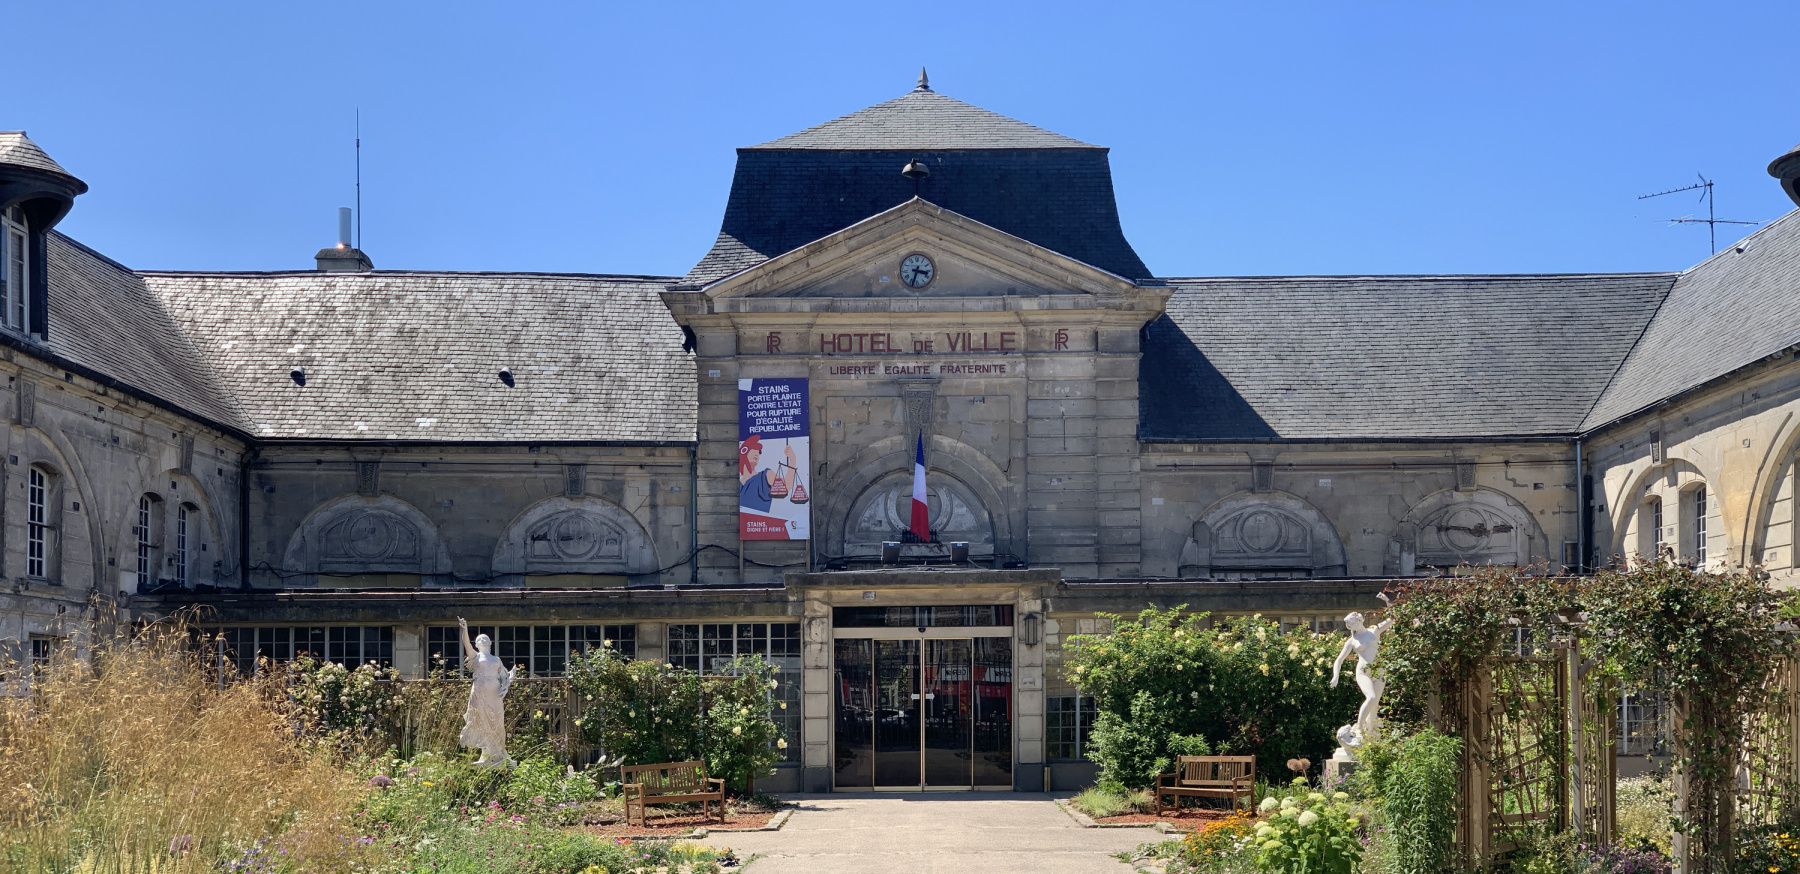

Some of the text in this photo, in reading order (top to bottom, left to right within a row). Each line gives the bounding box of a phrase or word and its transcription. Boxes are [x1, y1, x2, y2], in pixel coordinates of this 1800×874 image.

[820, 331, 1016, 353] HOTEL DE VILLE
[830, 364, 1006, 375] LIBERTE EGALITE FRATERNITE
[758, 385, 790, 394] STAINS
[747, 392, 801, 402] PORTE PLAINTE
[747, 401, 777, 410] CONTRE
[746, 408, 802, 418] POUR RUPTURE
